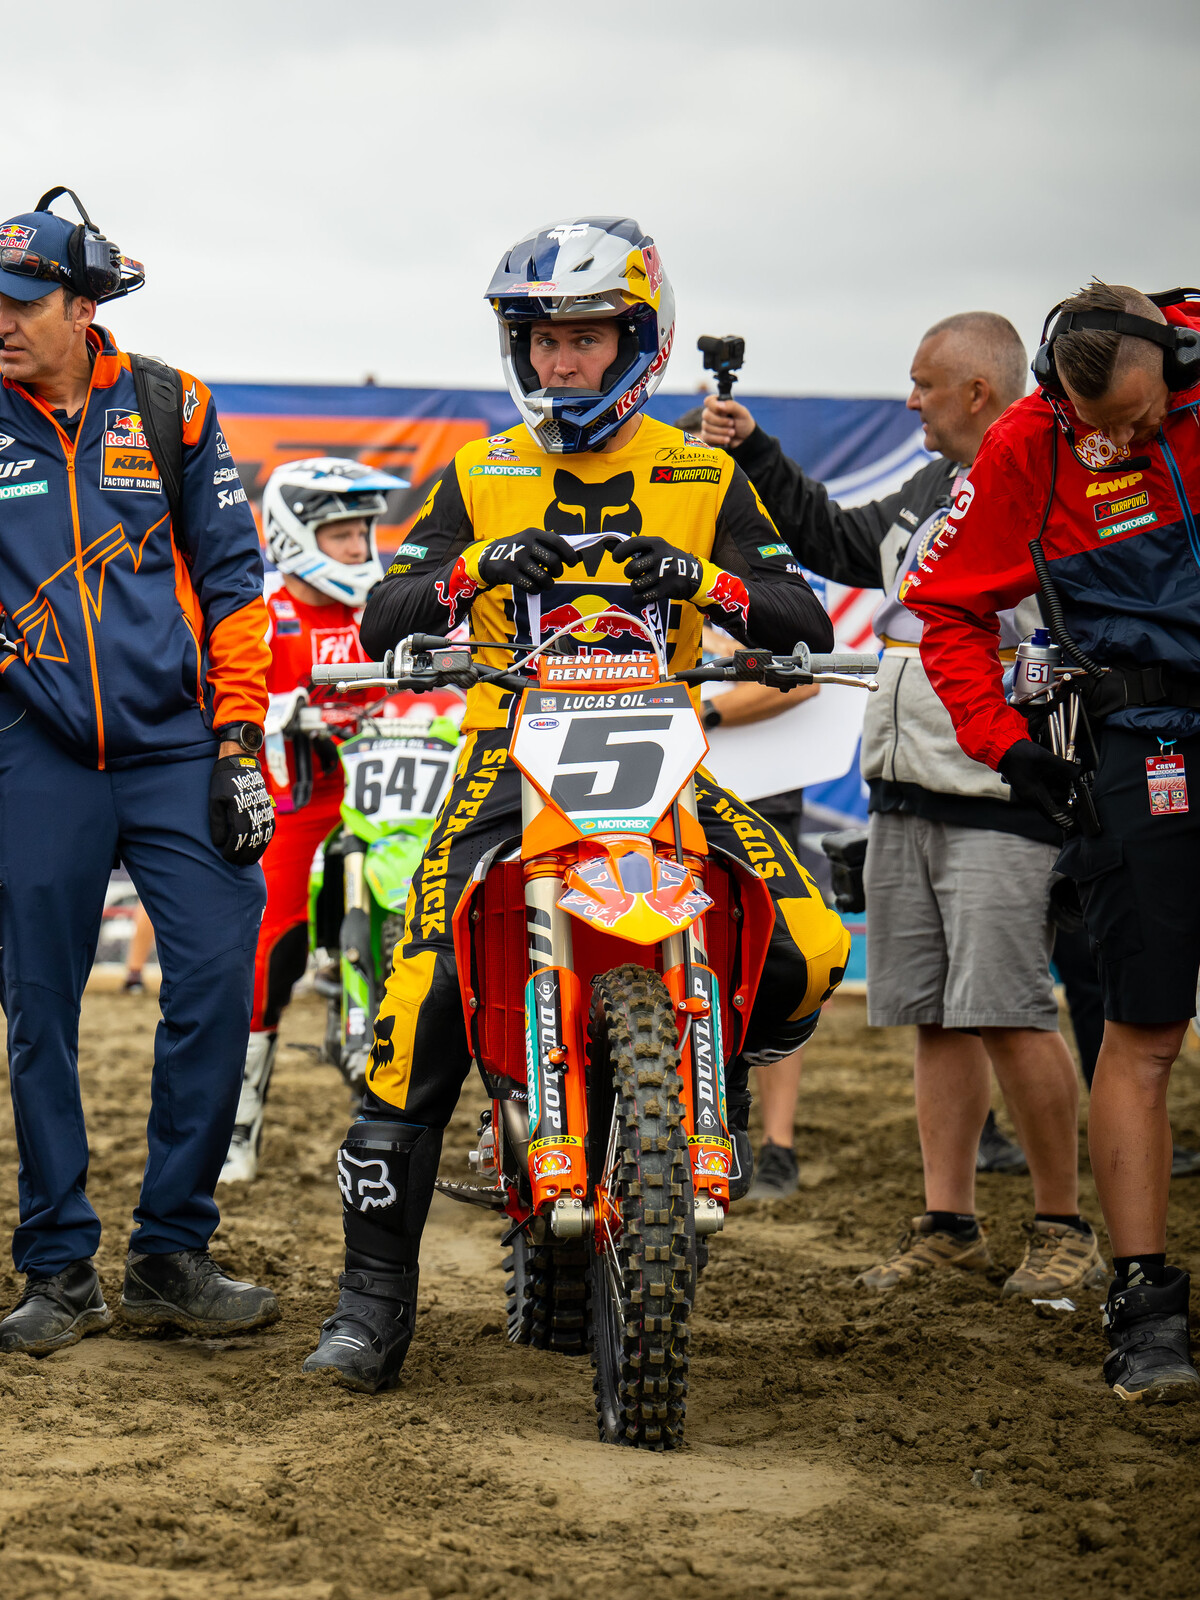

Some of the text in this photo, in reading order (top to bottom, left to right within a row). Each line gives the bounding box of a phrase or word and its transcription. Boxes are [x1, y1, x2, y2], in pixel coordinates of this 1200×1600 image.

[8, 238, 28, 249] Bull
[531, 285, 558, 293] Bull
[106, 431, 135, 446] Red
[112, 455, 154, 472] KTM
[484, 465, 539, 476] MOTOREX
[103, 476, 161, 489] FACTORY RACING
[1112, 513, 1157, 534] MOTOREX
[658, 556, 699, 580] FOX
[546, 665, 654, 682] RENTHAL
[1026, 665, 1050, 683] 51
[563, 693, 647, 710] LUCAS OIL
[549, 714, 674, 813] 5
[1155, 762, 1177, 770] CREW
[355, 756, 450, 816] 647
[1150, 778, 1185, 791] 2022
[597, 819, 650, 829] MOTOREX
[693, 977, 714, 1105] DUNLP
[530, 1136, 578, 1151] ACERBIS
